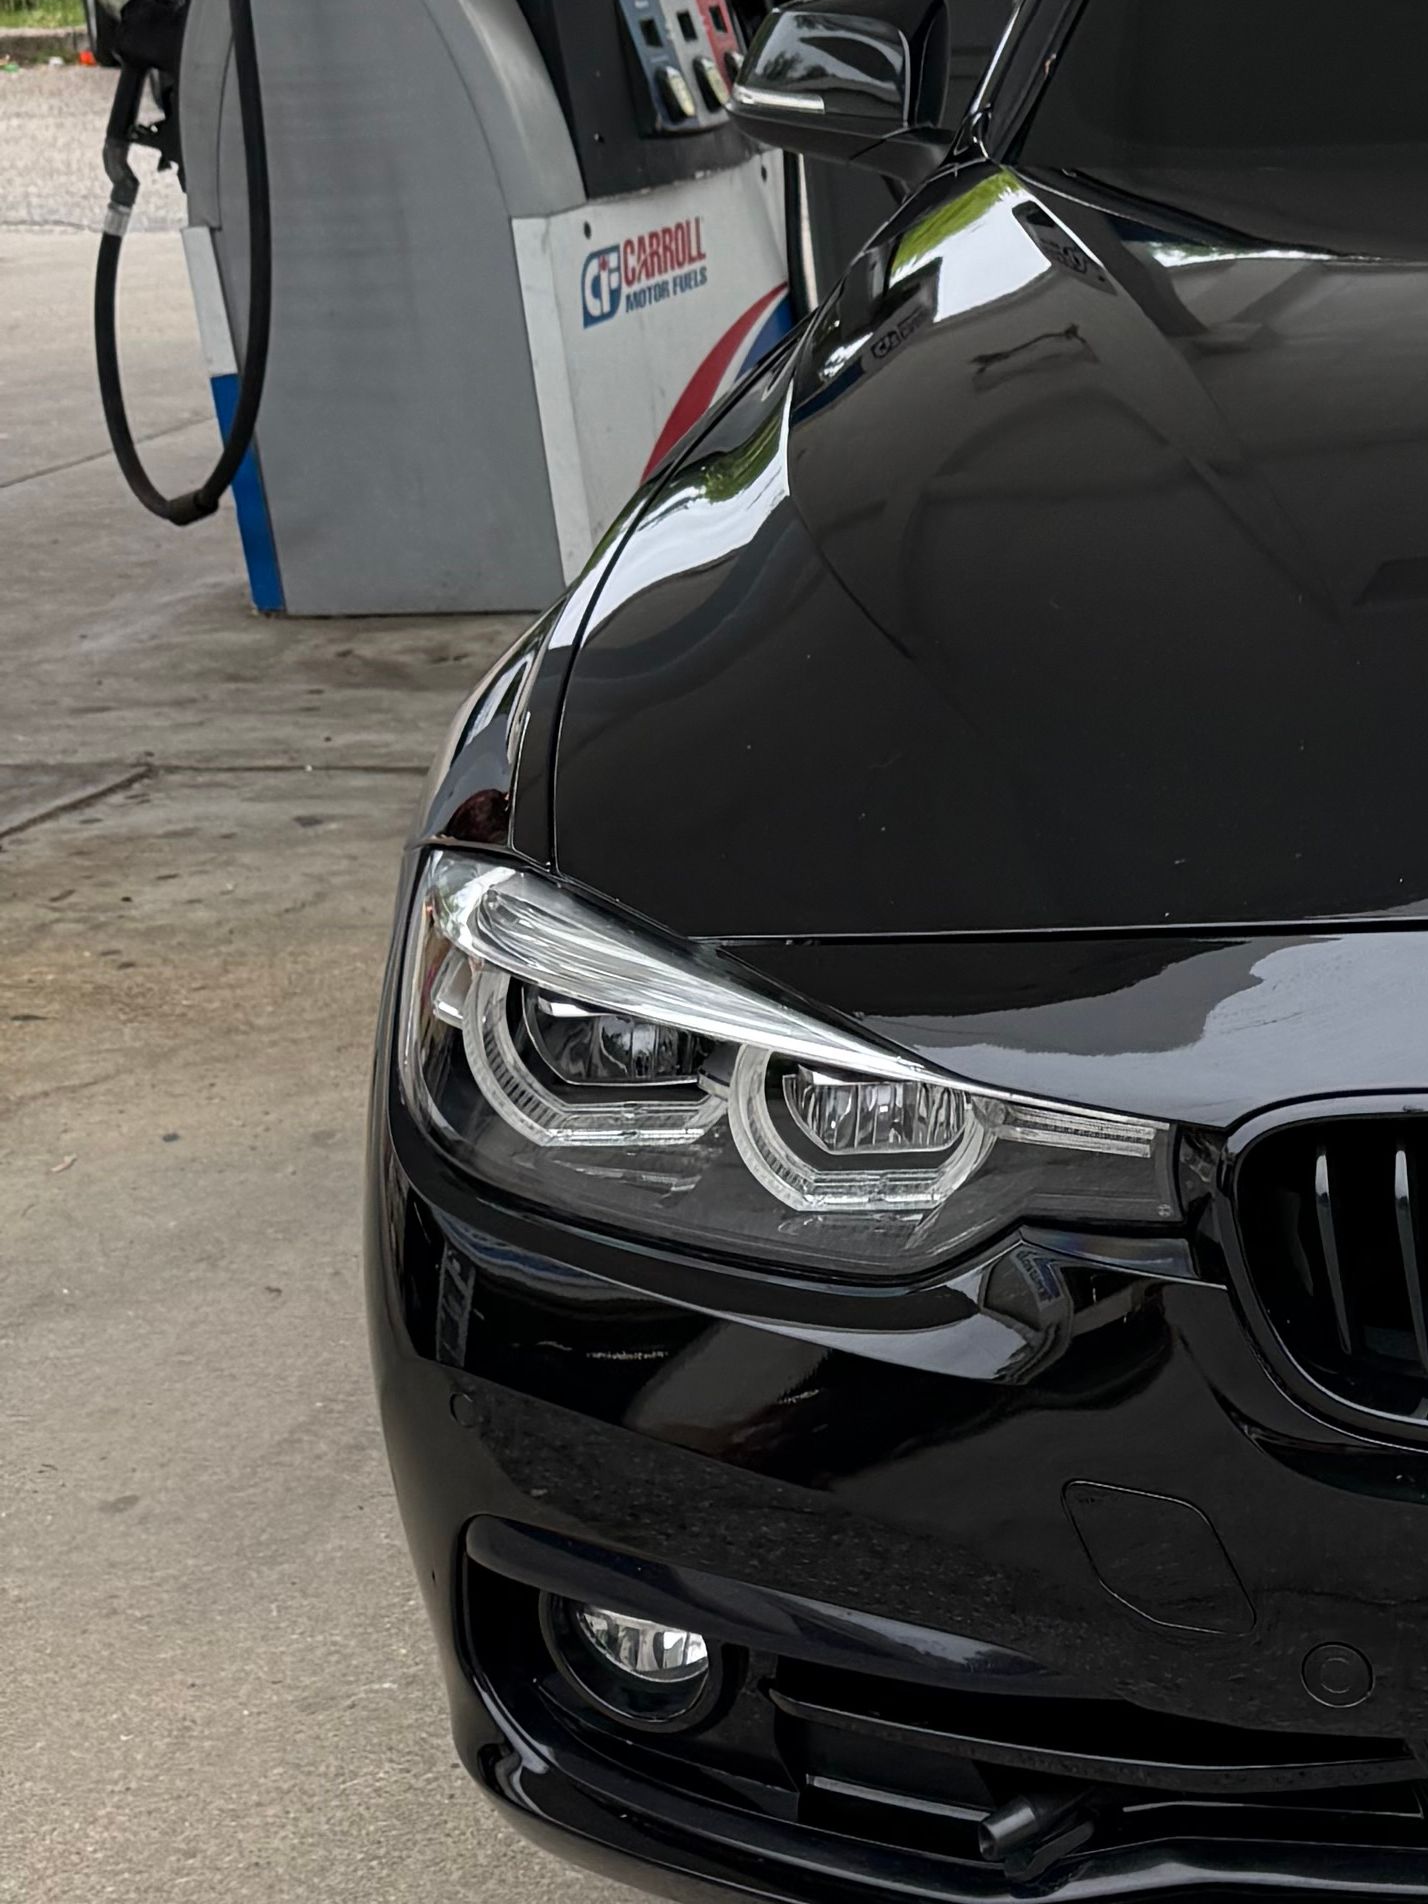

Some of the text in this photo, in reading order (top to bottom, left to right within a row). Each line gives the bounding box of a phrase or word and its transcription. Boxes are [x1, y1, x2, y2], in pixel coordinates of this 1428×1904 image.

[623, 216, 706, 288] CARROLL
[625, 266, 708, 313] MOTOR FUELS
